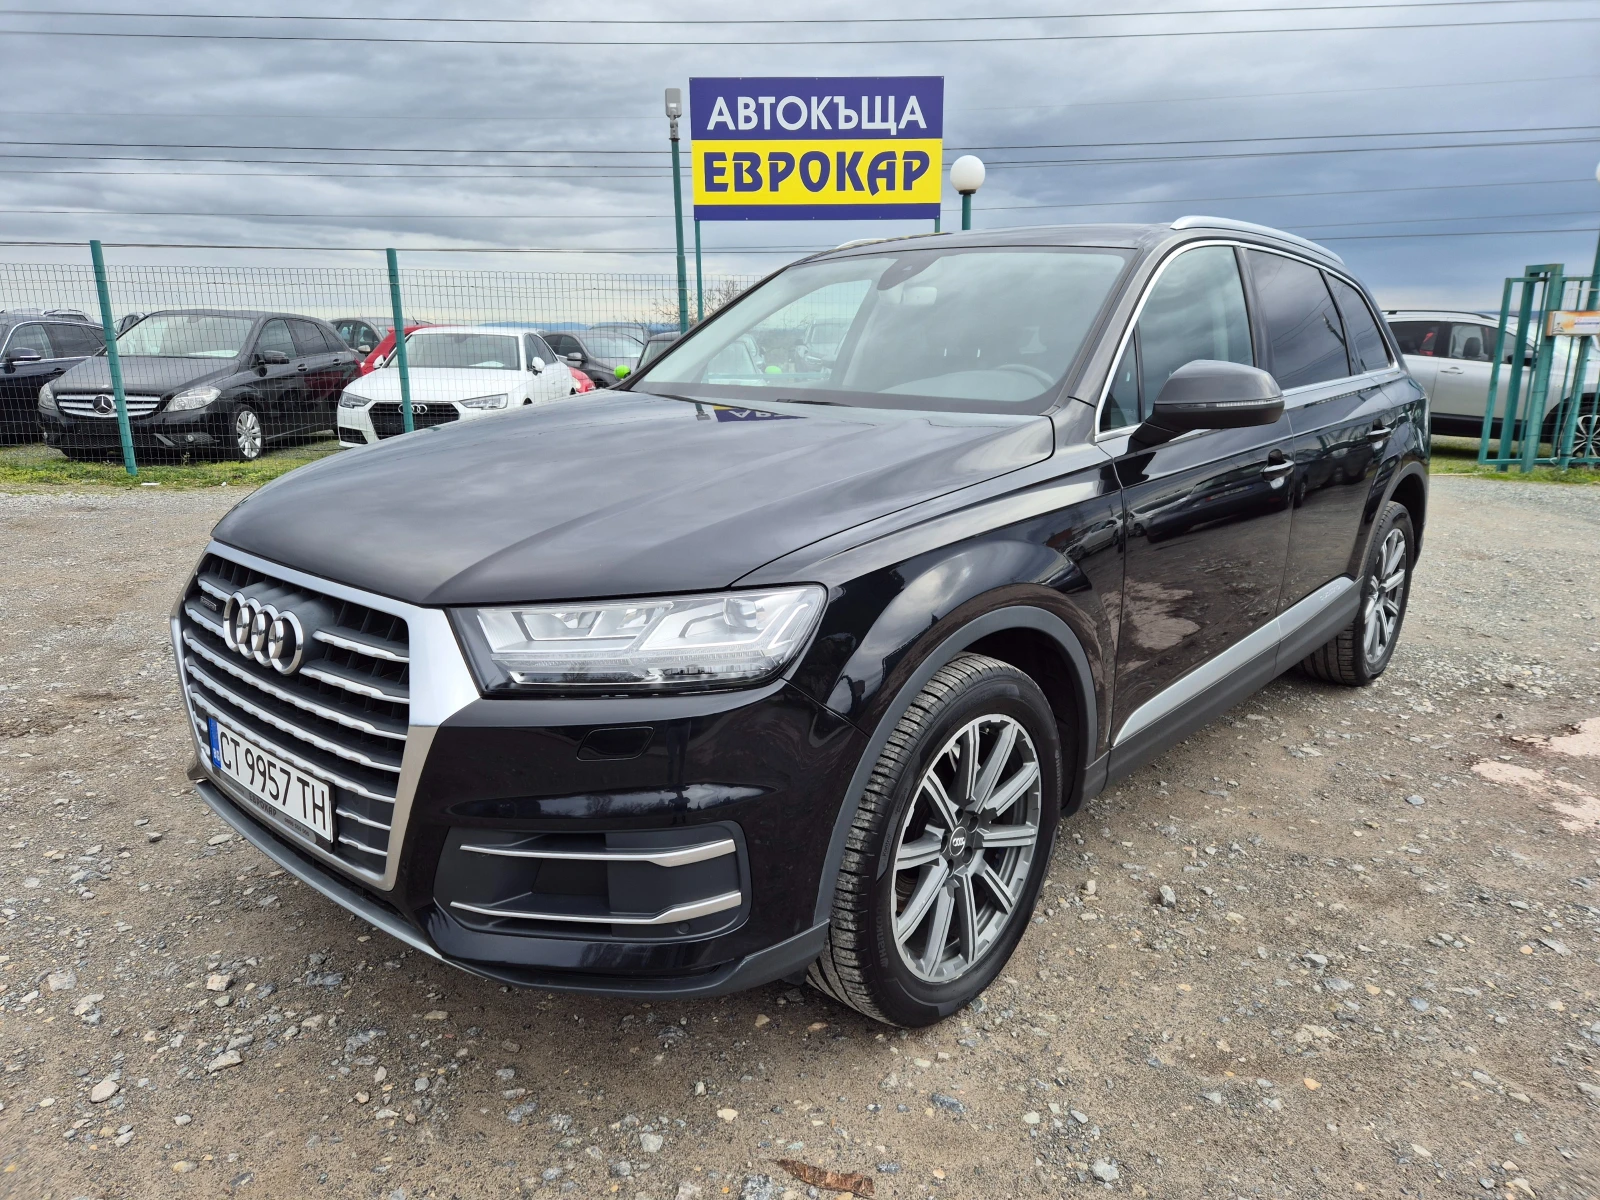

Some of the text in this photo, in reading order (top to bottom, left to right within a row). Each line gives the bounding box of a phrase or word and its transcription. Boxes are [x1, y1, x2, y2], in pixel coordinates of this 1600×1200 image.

[707, 95, 927, 135] АВТОКЪЩА
[704, 150, 930, 196] ЕВРОКАР
[245, 747, 291, 806] 9957
